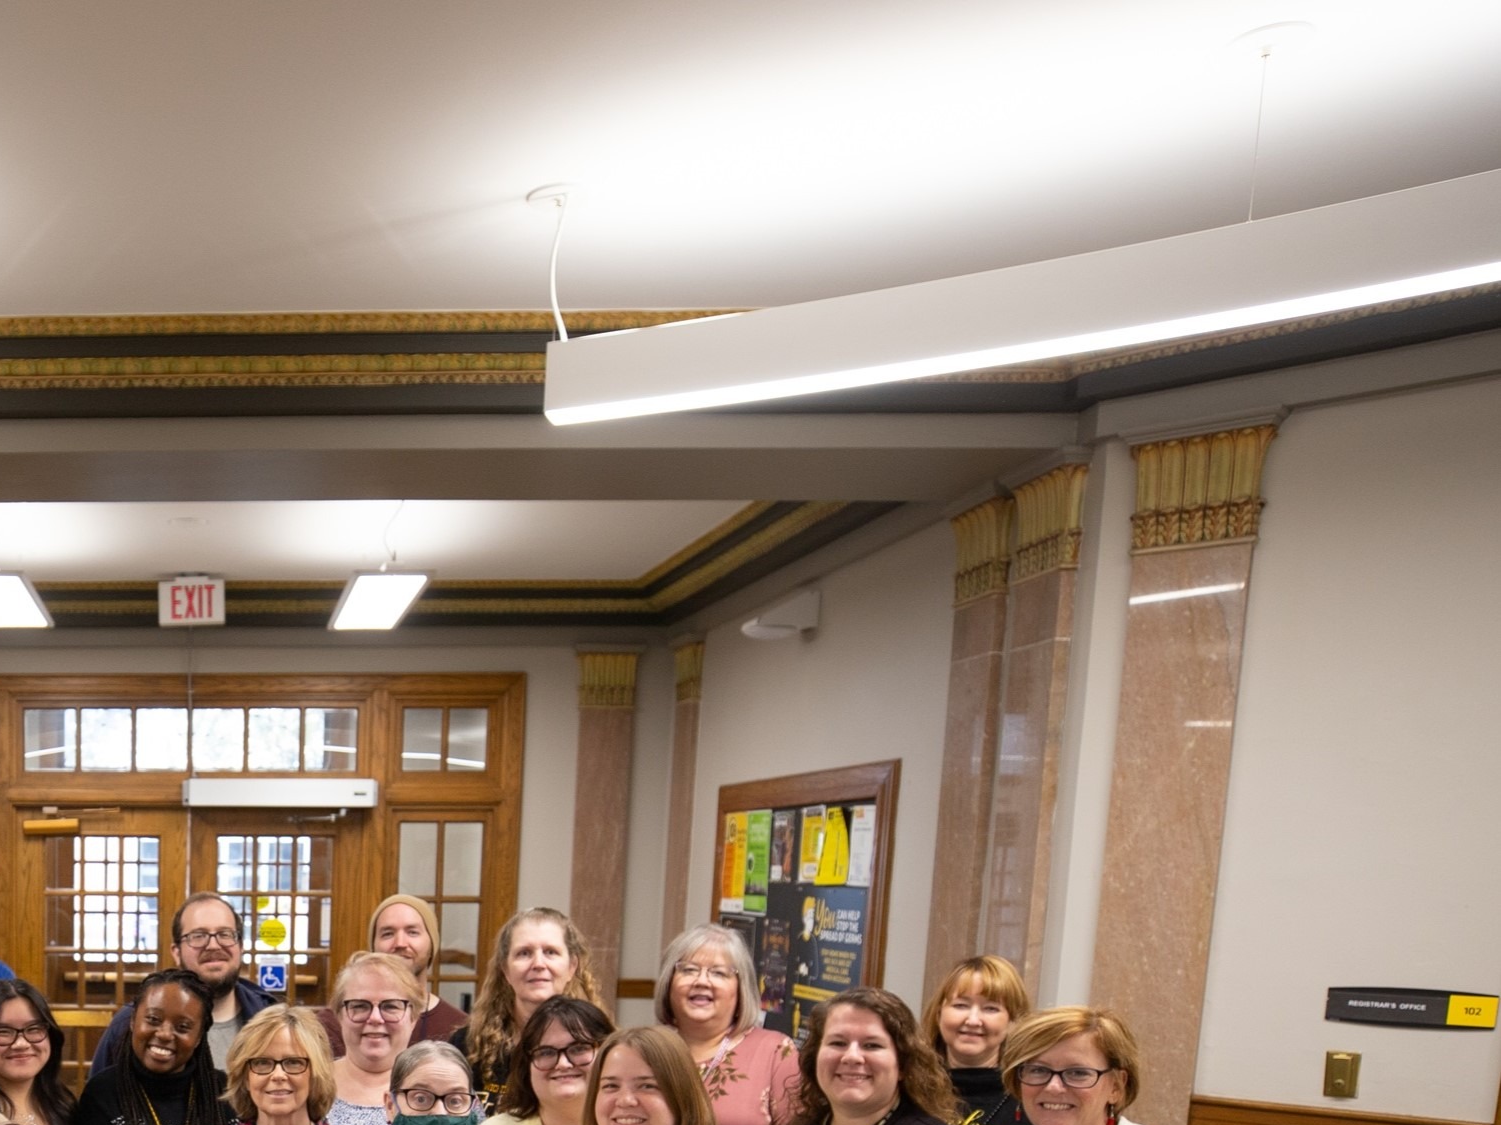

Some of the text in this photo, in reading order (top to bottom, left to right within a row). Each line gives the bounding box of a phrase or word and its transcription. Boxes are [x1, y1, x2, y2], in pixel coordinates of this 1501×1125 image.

[170, 585, 216, 620] EXIT
[848, 910, 861, 921] HELP
[836, 920, 849, 931] STOP
[1347, 999, 1427, 1012] REGISTRAR'S OFFICE
[1463, 1007, 1482, 1016] 102
